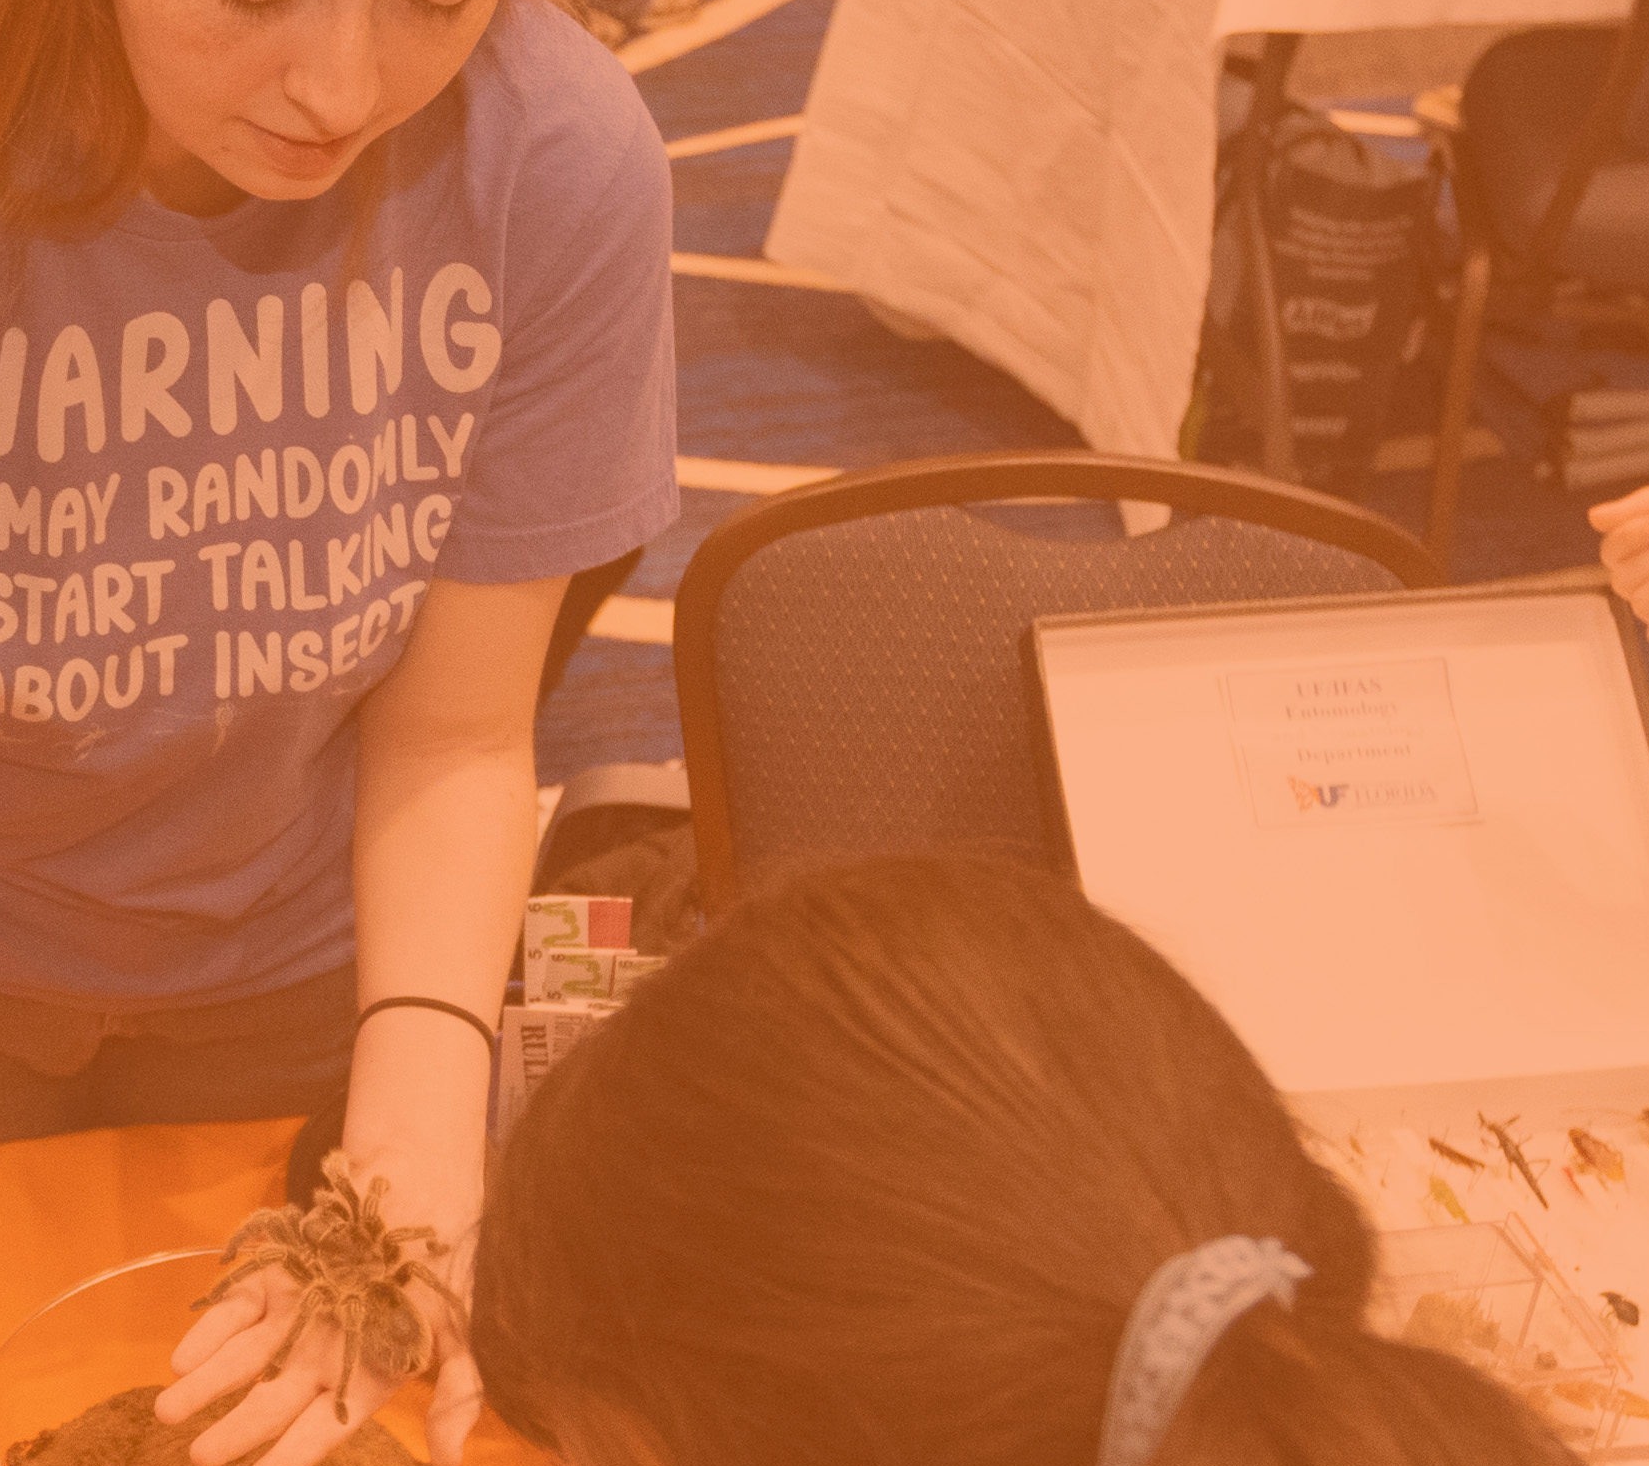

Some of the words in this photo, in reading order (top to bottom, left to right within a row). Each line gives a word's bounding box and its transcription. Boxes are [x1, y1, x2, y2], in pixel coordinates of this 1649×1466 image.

[147, 410, 476, 541] RANDOMLY
[198, 493, 454, 614] TALKING
[1294, 675, 1385, 700] UF/IFAS
[1296, 742, 1413, 767] Department
[1315, 781, 1352, 811] UF
